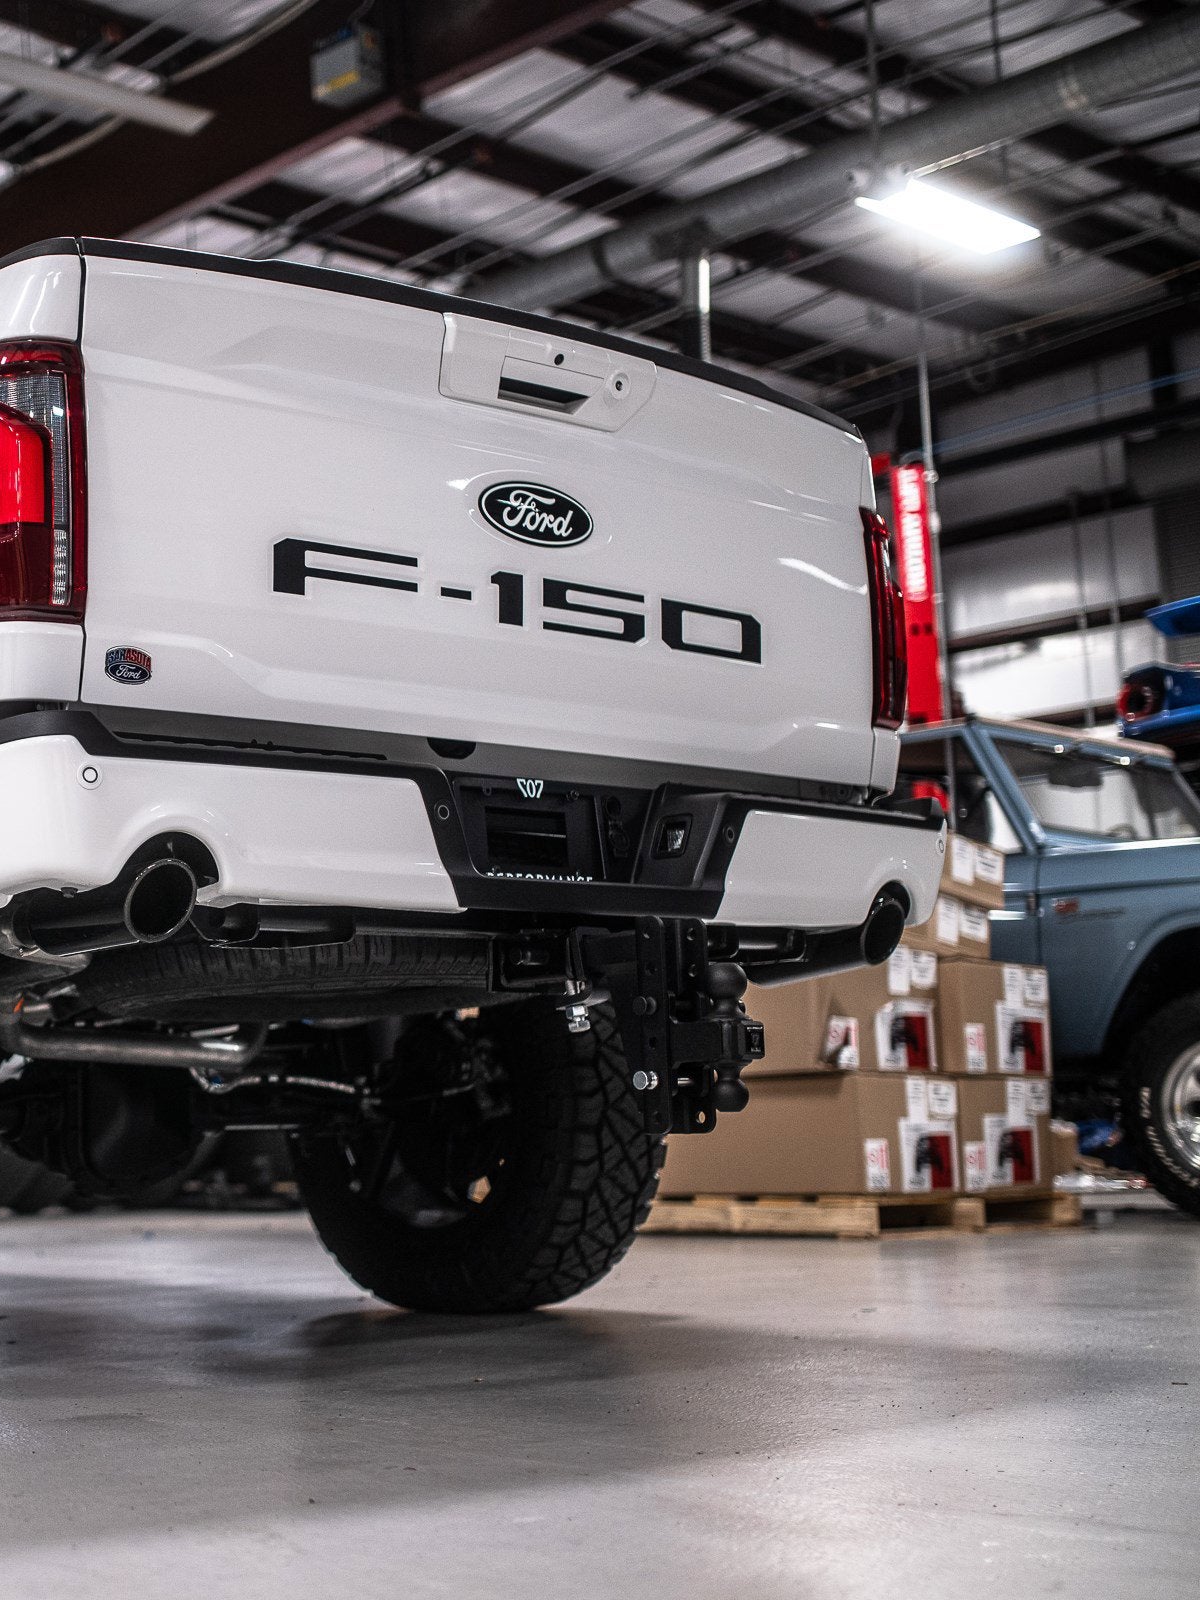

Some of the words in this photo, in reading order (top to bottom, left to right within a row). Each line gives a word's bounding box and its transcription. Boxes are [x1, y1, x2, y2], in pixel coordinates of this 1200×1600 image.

[497, 489, 573, 538] Ford
[273, 538, 762, 664] F-150
[116, 664, 142, 679] Ford
